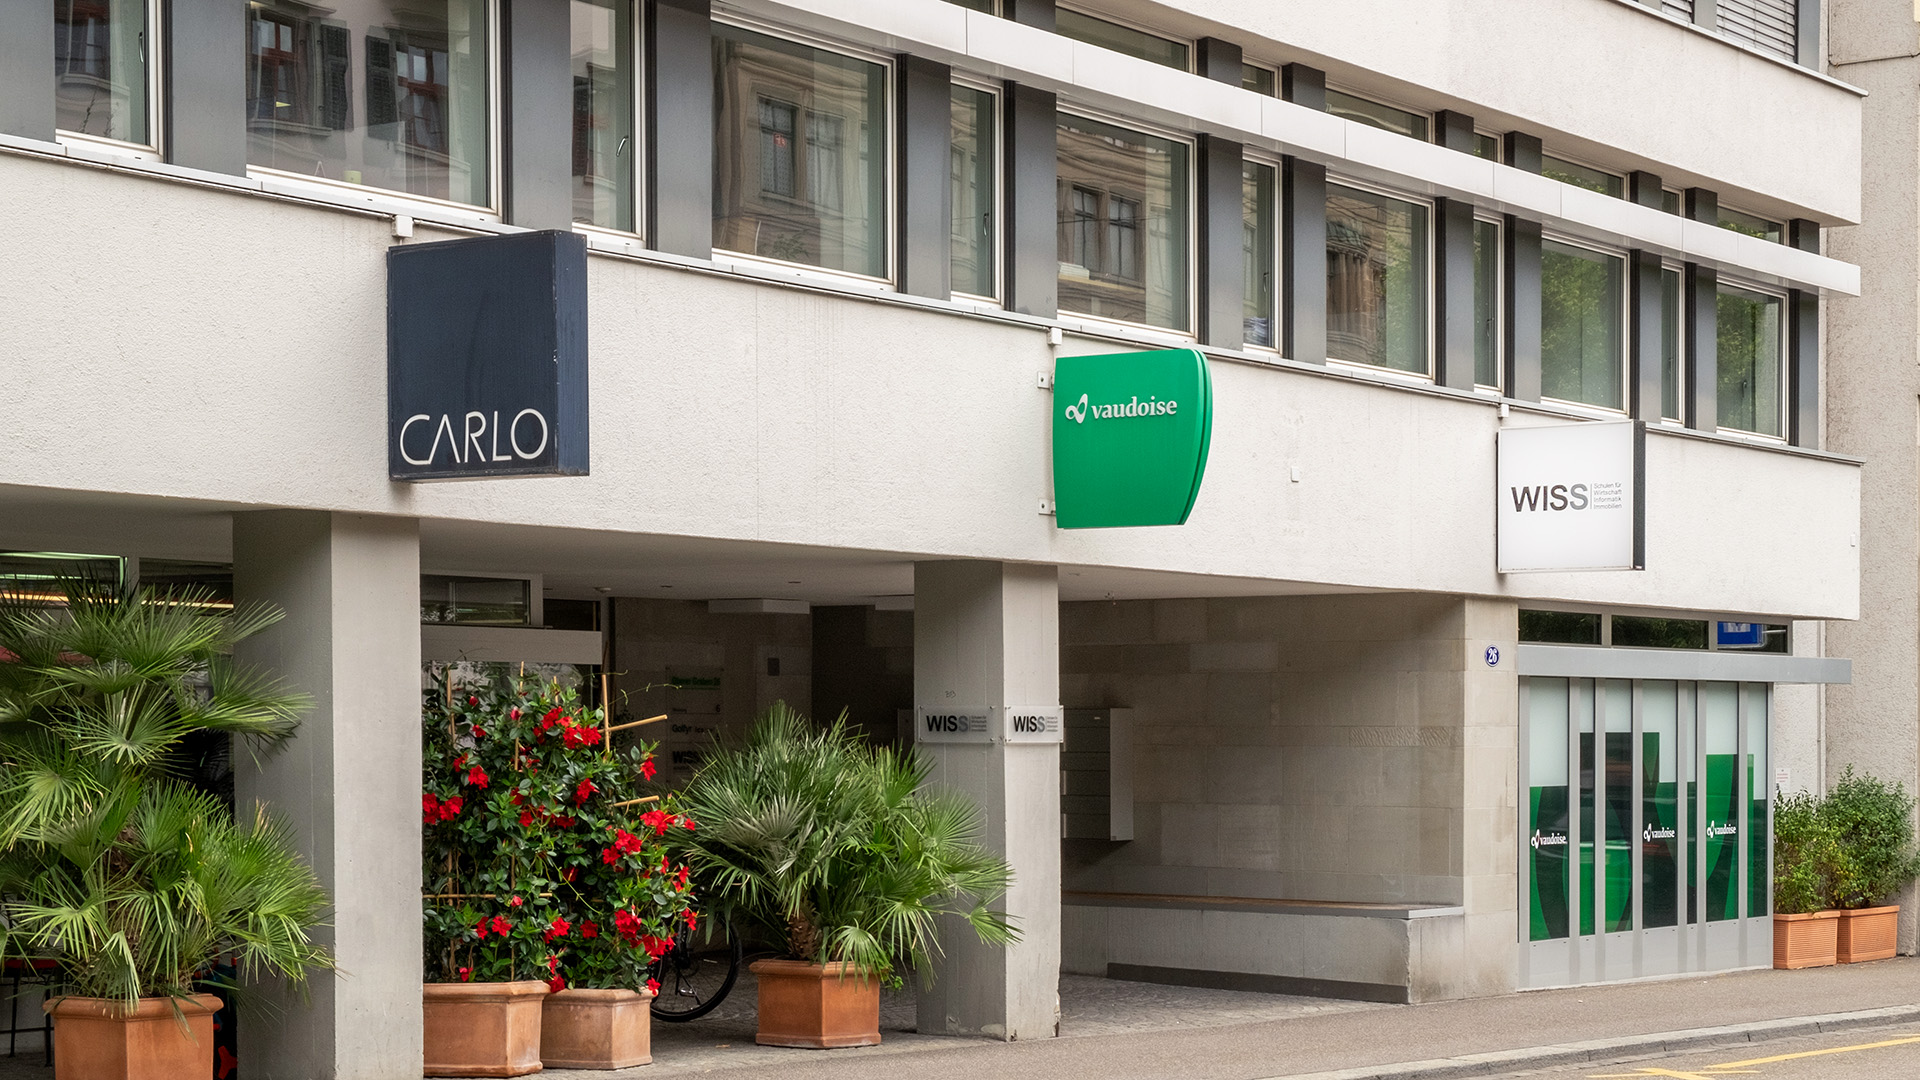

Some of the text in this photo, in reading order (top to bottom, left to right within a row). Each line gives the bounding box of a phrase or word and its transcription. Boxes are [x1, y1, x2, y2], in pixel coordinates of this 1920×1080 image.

[1091, 396, 1177, 419] vaudoise
[400, 408, 548, 465] CARLO
[1511, 483, 1589, 512] WISS
[1488, 648, 1498, 663] 26
[926, 715, 969, 732] WISS
[1013, 715, 1046, 732] WISS
[1651, 827, 1675, 839] vaudoise
[1714, 824, 1736, 835] vaudoise
